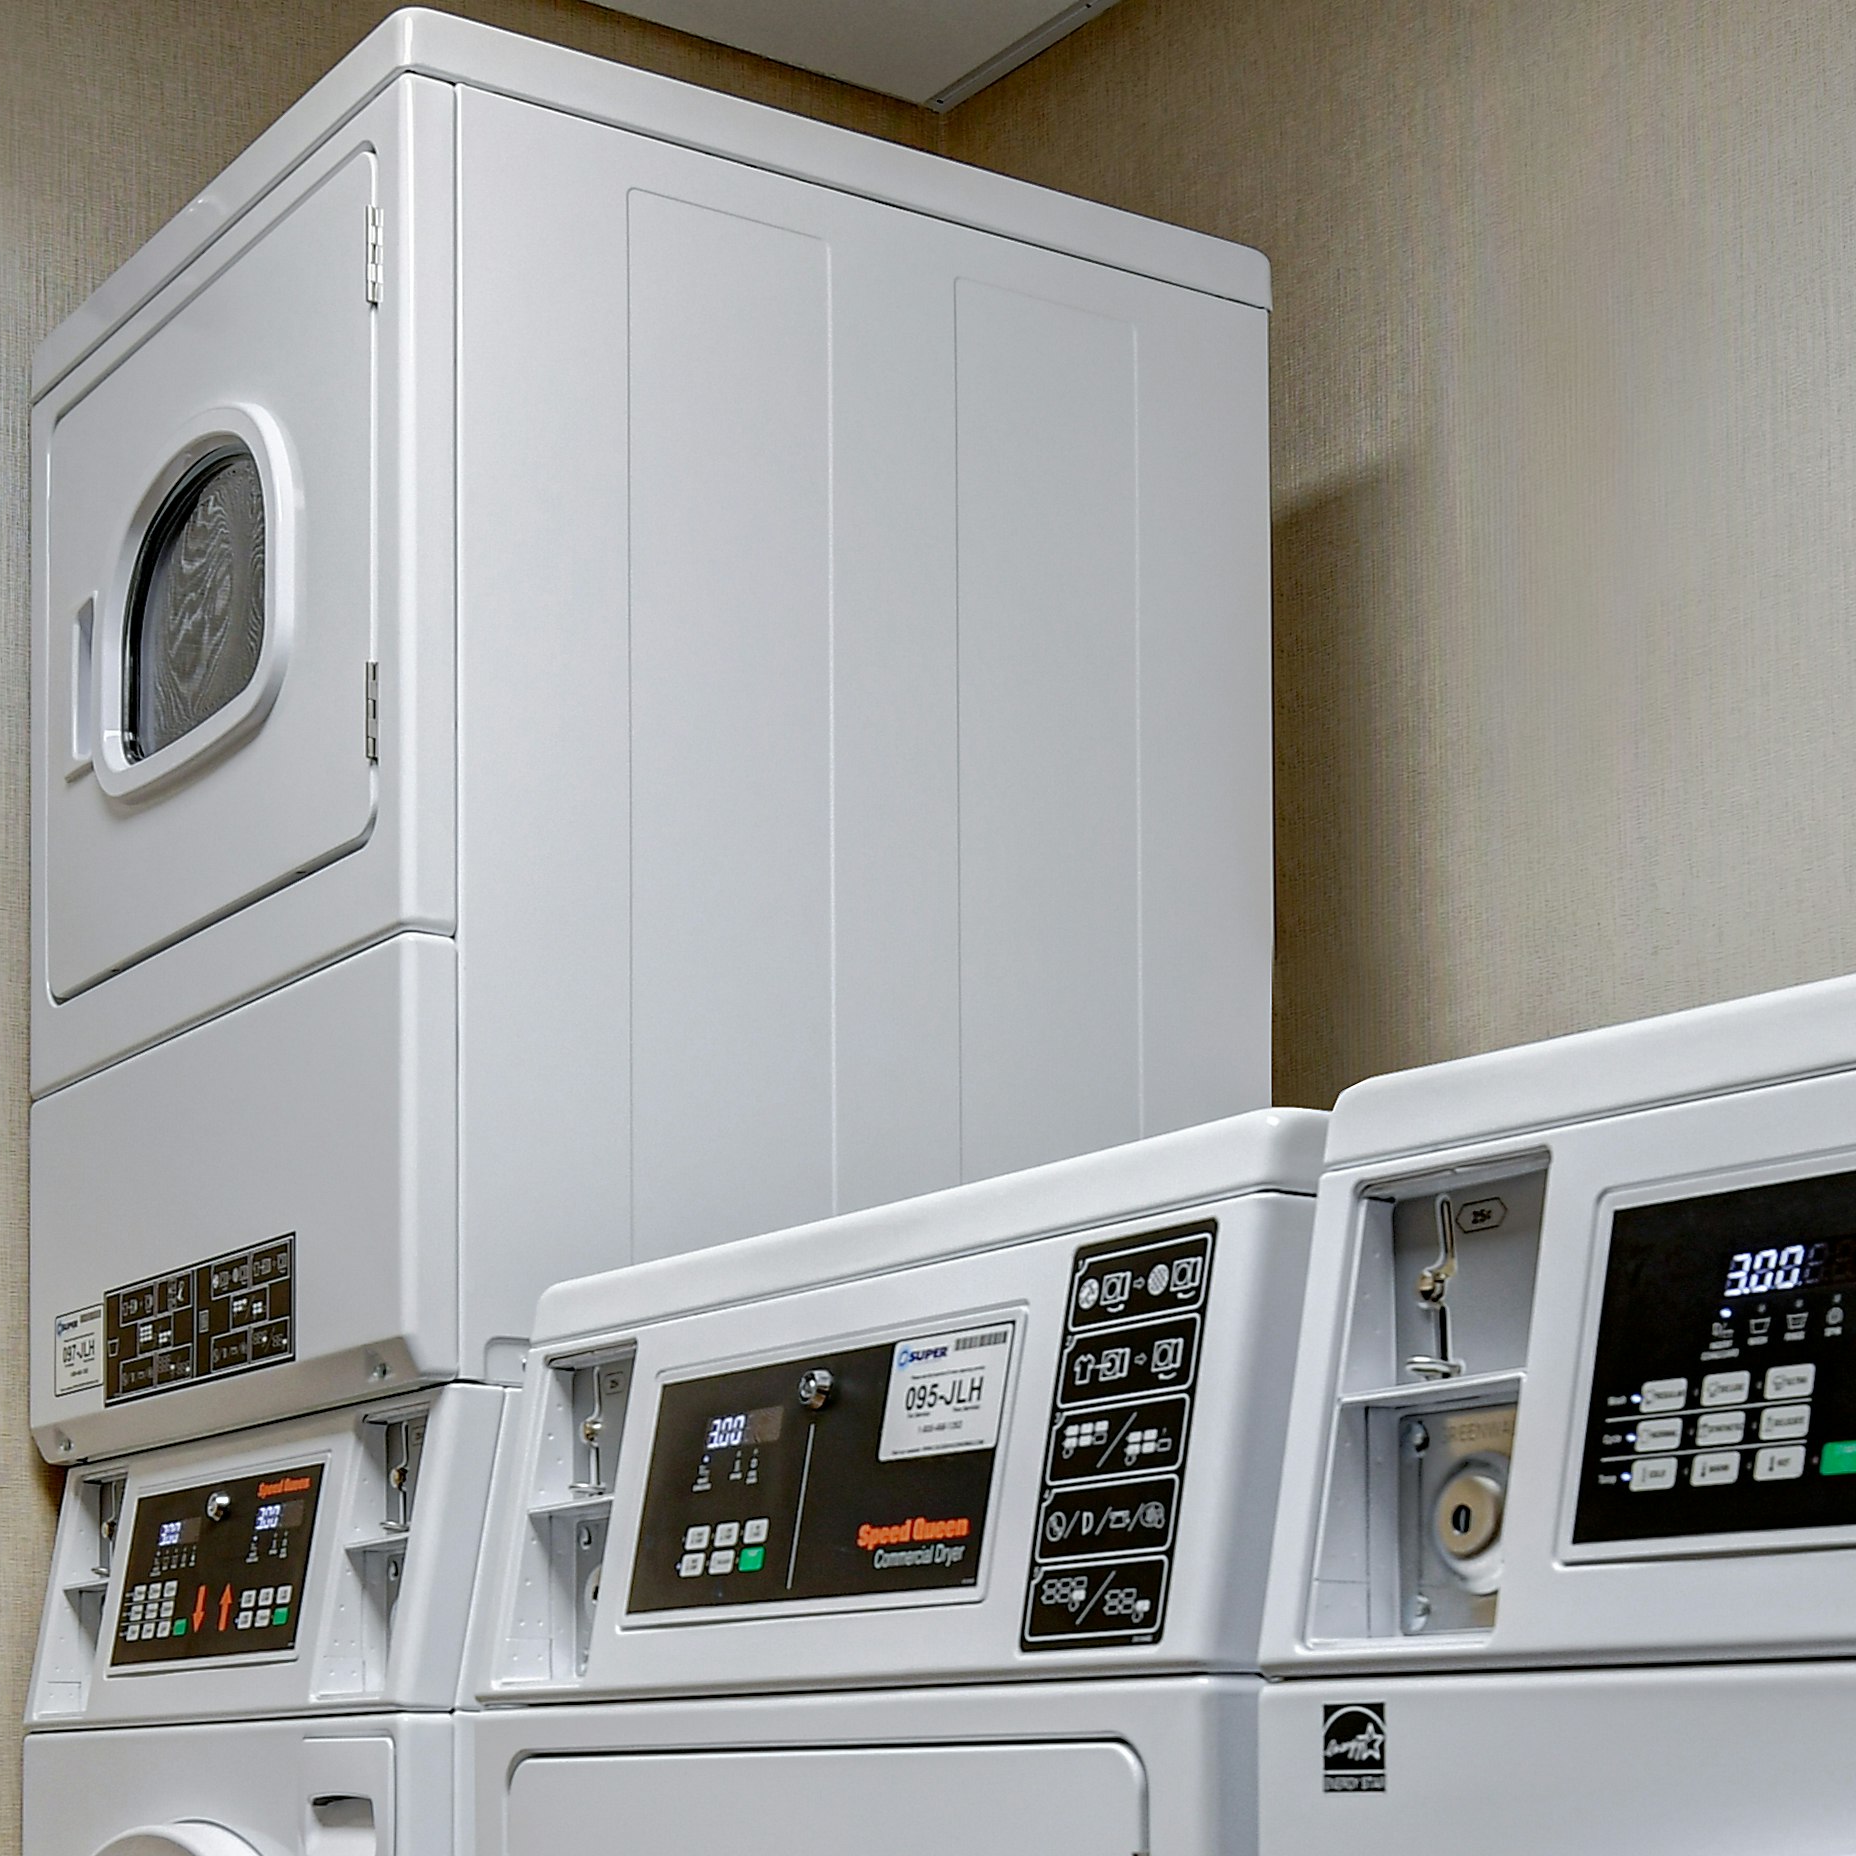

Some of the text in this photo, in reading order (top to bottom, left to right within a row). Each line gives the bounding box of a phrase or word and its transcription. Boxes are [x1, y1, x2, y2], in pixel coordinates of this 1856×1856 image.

[909, 1346, 948, 1362] SUPER
[905, 1376, 984, 1411] 095-JLH
[857, 1516, 970, 1550] Speed Queen
[874, 1543, 966, 1569] Commercial Dryer
